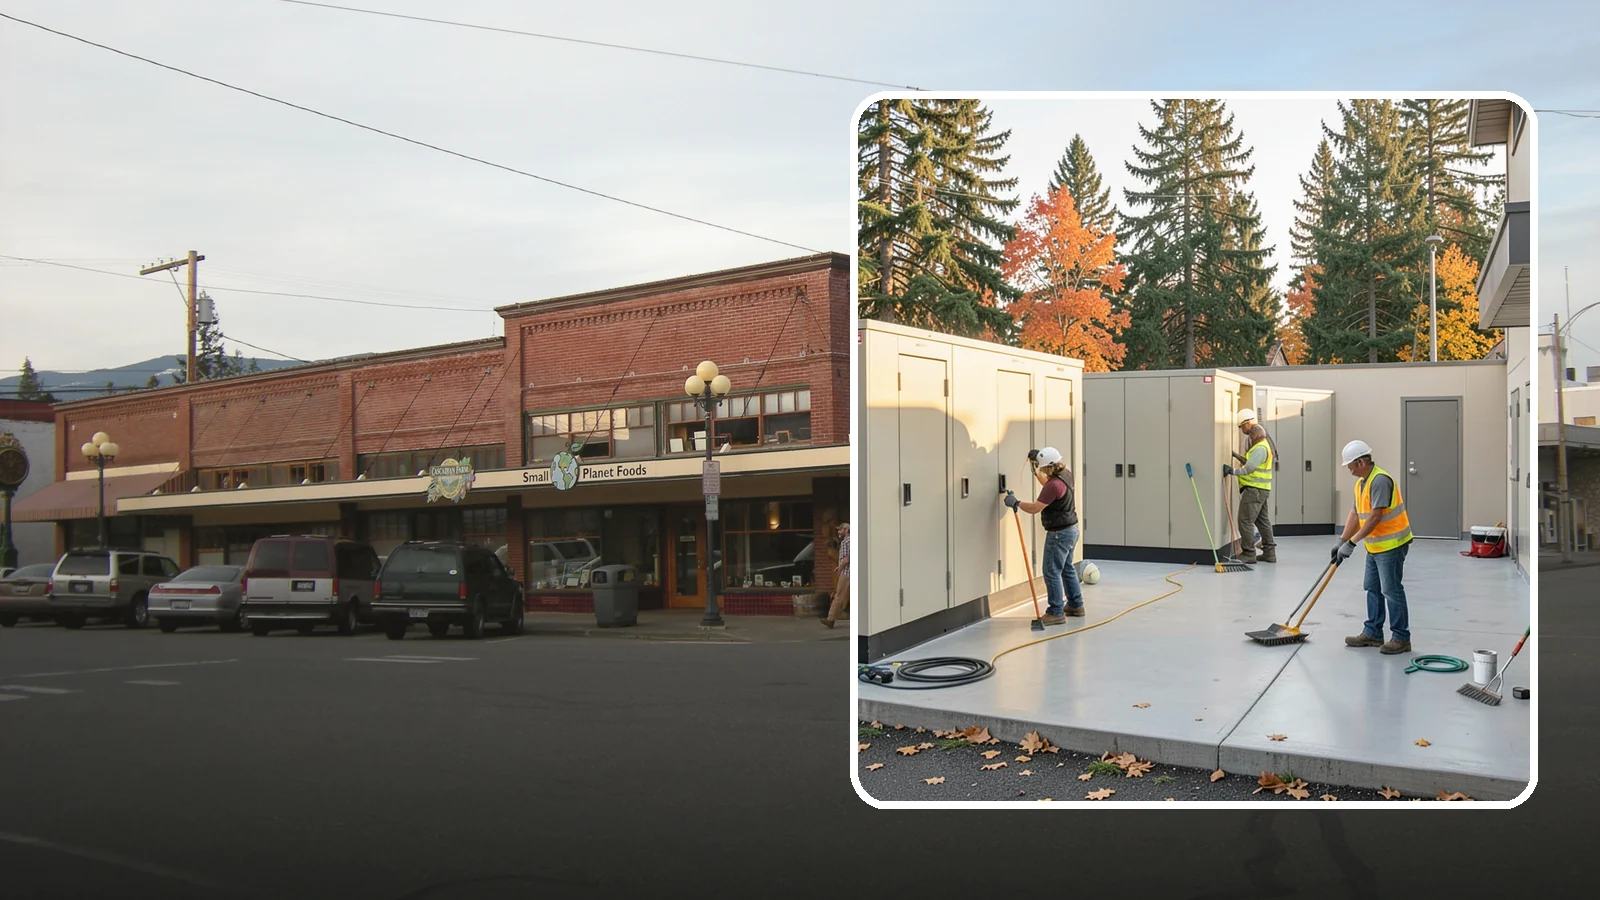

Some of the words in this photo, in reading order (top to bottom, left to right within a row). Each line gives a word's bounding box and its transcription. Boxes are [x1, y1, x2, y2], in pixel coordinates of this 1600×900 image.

[523, 471, 549, 483] Small
[582, 467, 614, 479] Planet
[616, 464, 647, 477] Foods
